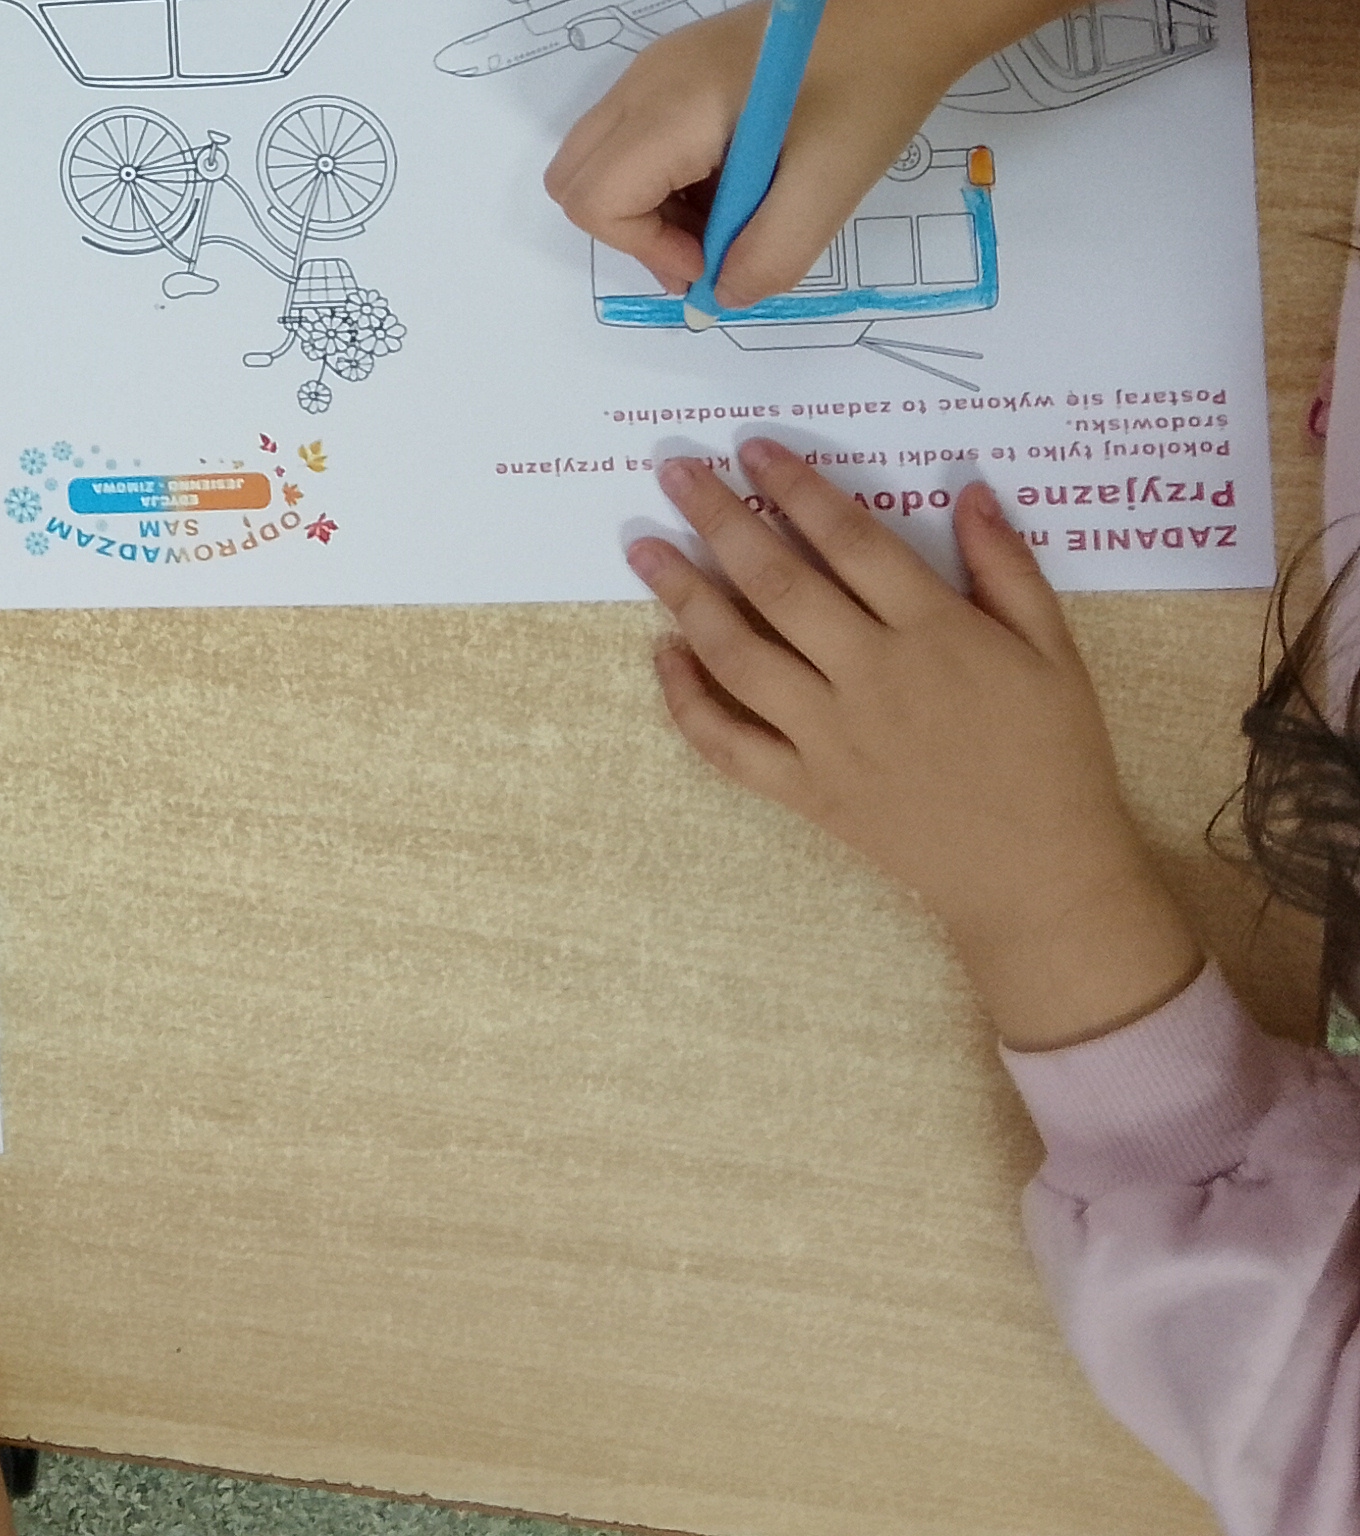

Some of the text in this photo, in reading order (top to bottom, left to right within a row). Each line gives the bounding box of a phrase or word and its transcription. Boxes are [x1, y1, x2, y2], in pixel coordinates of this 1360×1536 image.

[790, 387, 1228, 420] Postaraj się to zadanie
[990, 438, 1231, 463] Pokoloruj tylko te
[494, 455, 616, 478] przyjazne
[624, 457, 654, 473] są
[91, 480, 154, 494] ZIMOWA
[1016, 474, 1236, 512] Przyjazne
[45, 511, 301, 563] ODPROWADZAM
[139, 519, 198, 536] SAM
[1064, 523, 1238, 553] ZADANIE
